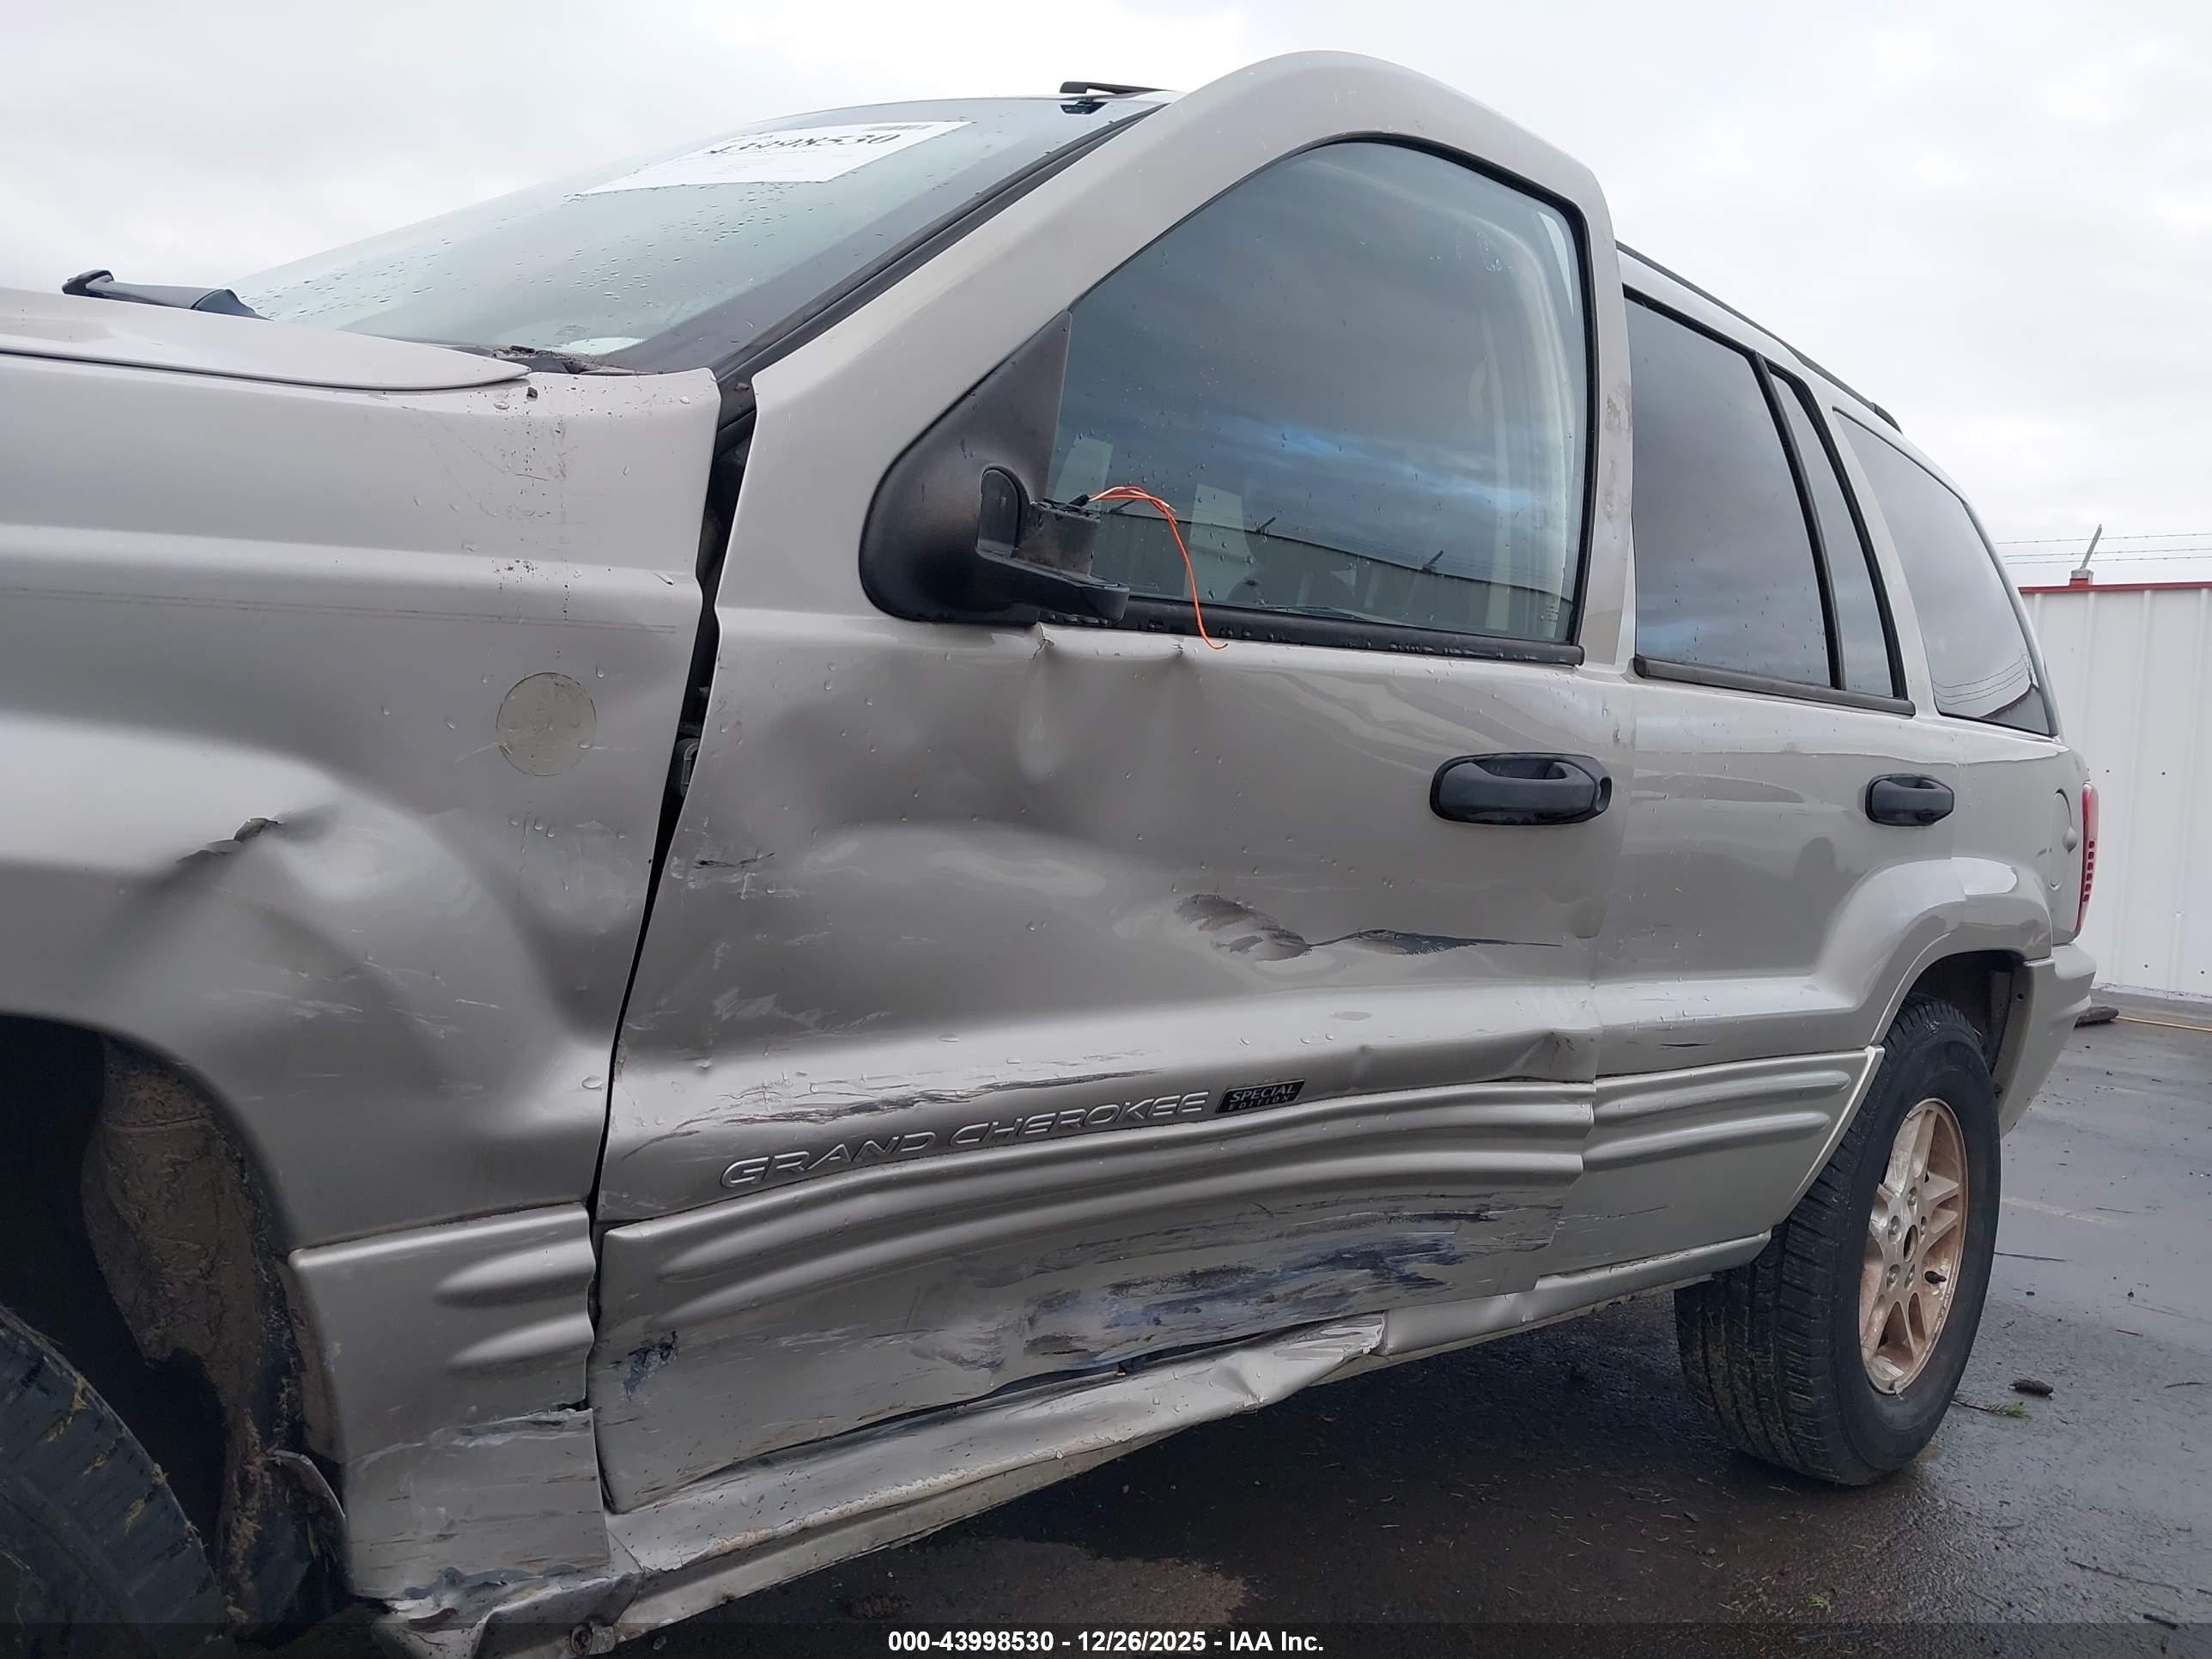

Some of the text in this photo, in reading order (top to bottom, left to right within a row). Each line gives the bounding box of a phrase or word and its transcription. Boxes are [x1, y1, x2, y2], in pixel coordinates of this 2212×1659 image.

[1228, 1095, 1291, 1110] EDITION
[1229, 1085, 1296, 1103] SPECIAL
[720, 1091, 1210, 1188] GRAND CHEROKEE
